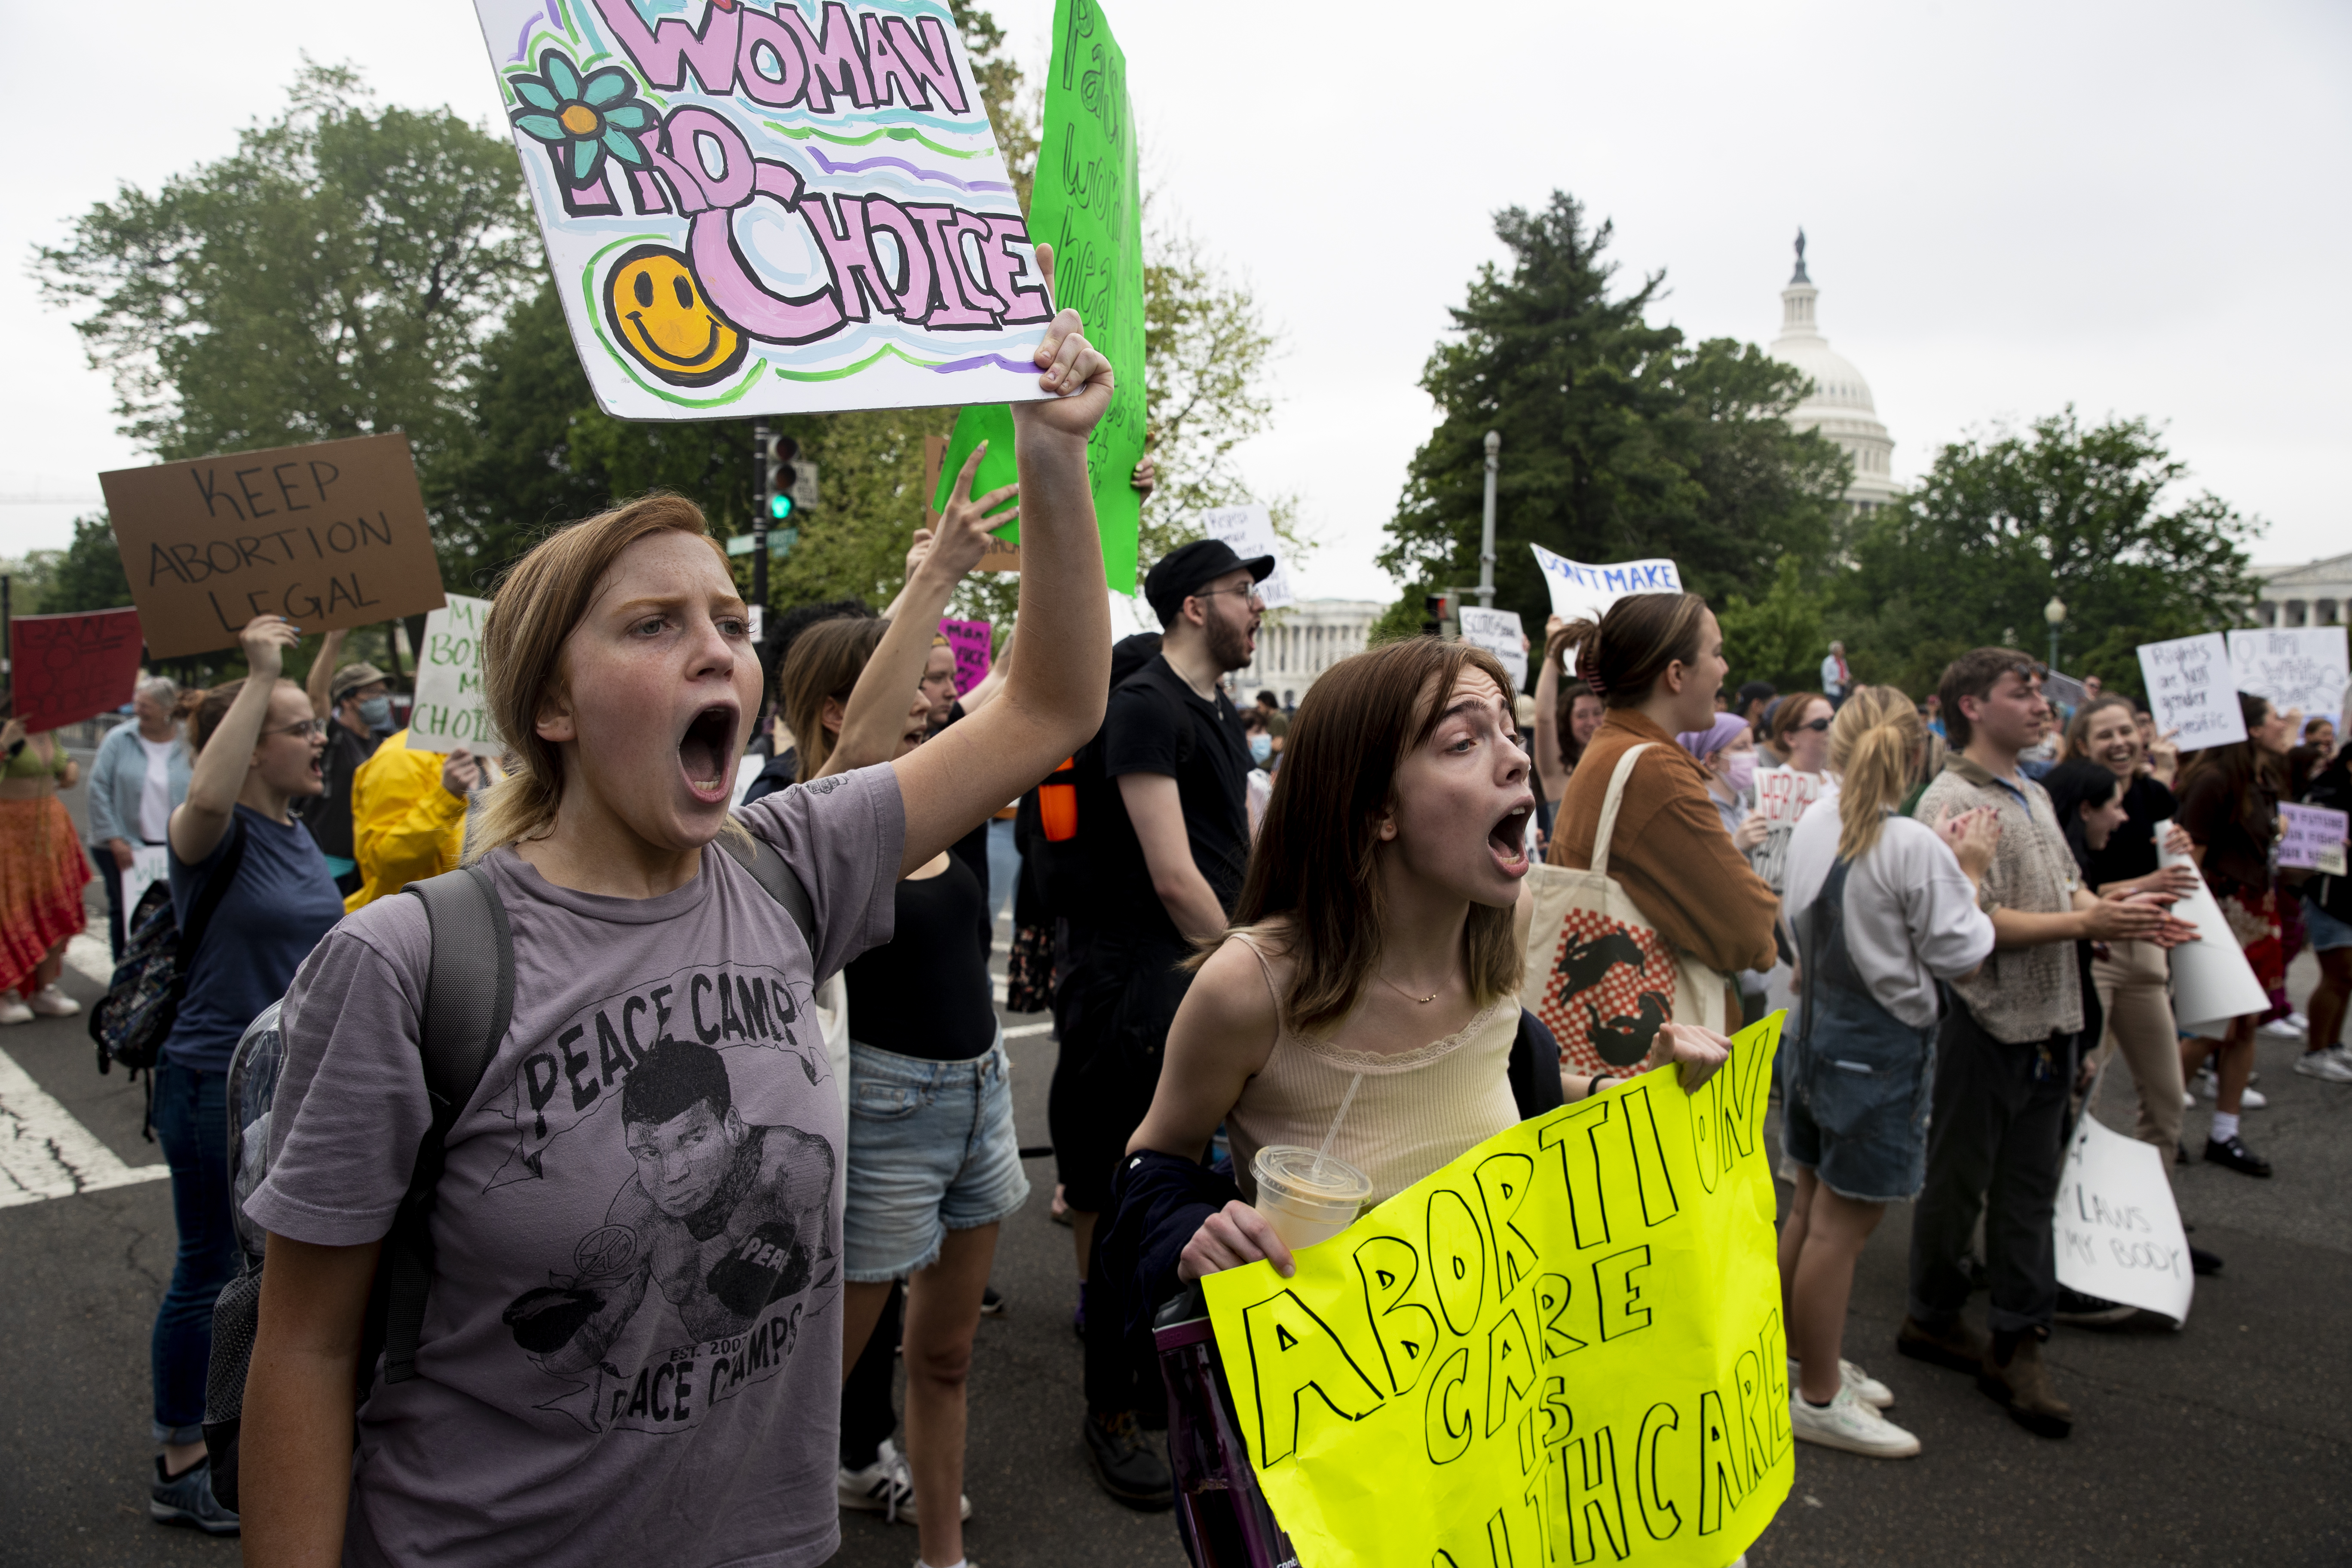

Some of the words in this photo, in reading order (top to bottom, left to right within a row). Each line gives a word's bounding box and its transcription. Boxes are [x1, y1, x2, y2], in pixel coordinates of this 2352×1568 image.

[595, 0, 971, 114] WOMAN
[192, 461, 339, 521] KEEP
[150, 511, 392, 586] ABORTION
[1603, 565, 1677, 592] MAKE
[209, 573, 380, 633] LEGAL
[524, 984, 673, 1141] PEACE
[2076, 1182, 2152, 1234] LAWS
[1242, 1027, 1770, 1468] ABORTION
[2110, 1236, 2181, 1280] BODY
[670, 1346, 702, 1363] EST.
[1425, 1244, 1652, 1465] CARE
[1518, 1376, 1573, 1476] IS
